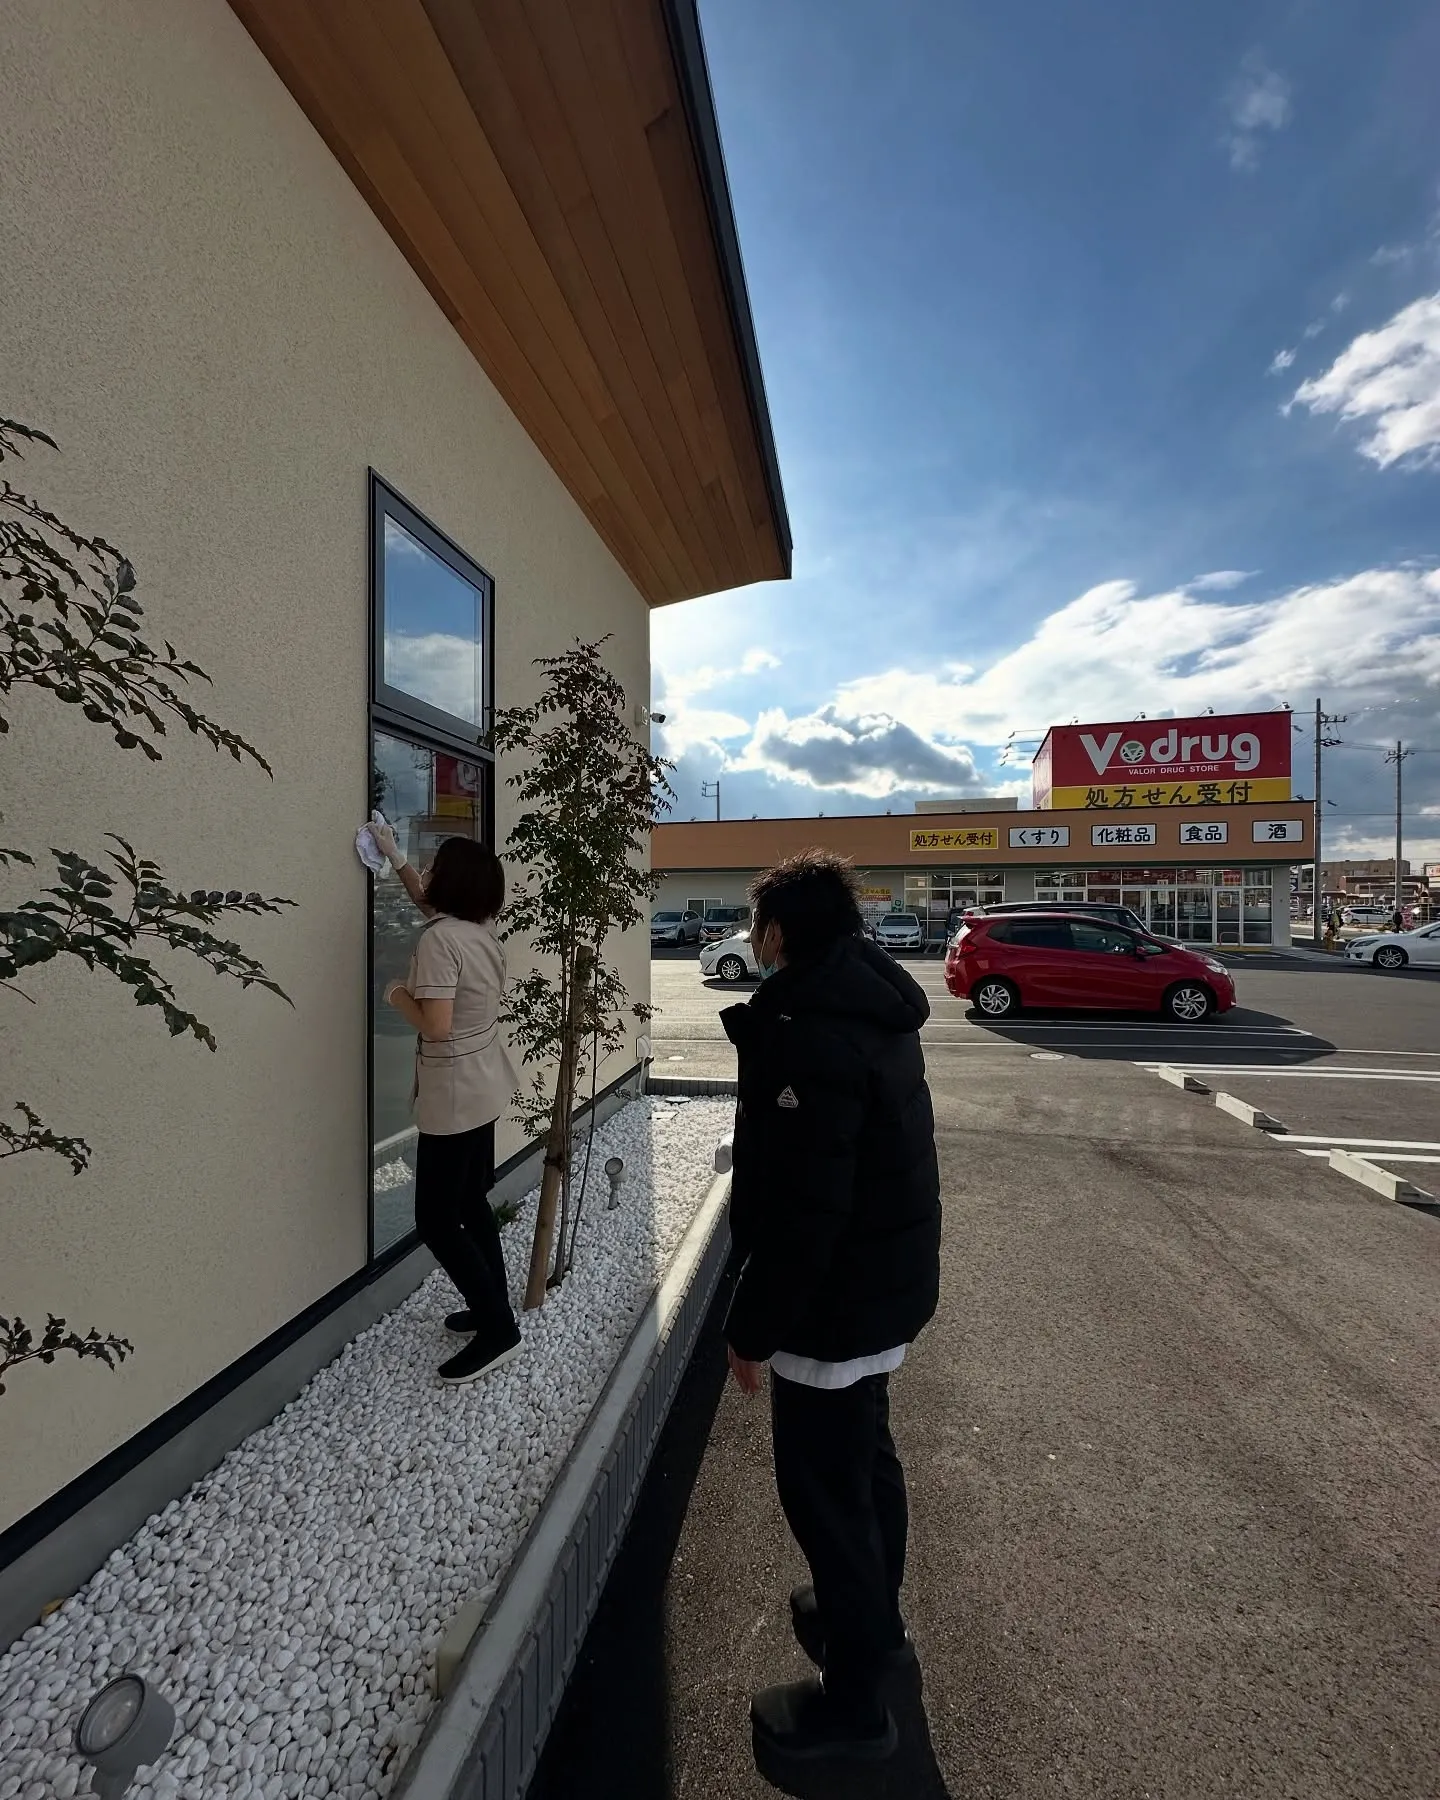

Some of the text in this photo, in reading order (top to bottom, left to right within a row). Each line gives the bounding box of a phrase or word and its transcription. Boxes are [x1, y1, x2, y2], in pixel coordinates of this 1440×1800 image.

[1160, 766, 1185, 774] DRUG
[1189, 764, 1220, 773] STORE
[1085, 781, 1253, 808] 処方せん受付
[914, 832, 993, 847] 処方せん受付
[1018, 829, 1060, 845] くすり
[1097, 827, 1151, 843] 化粧品
[1185, 825, 1222, 841] 食品
[1267, 823, 1287, 840] 酒
